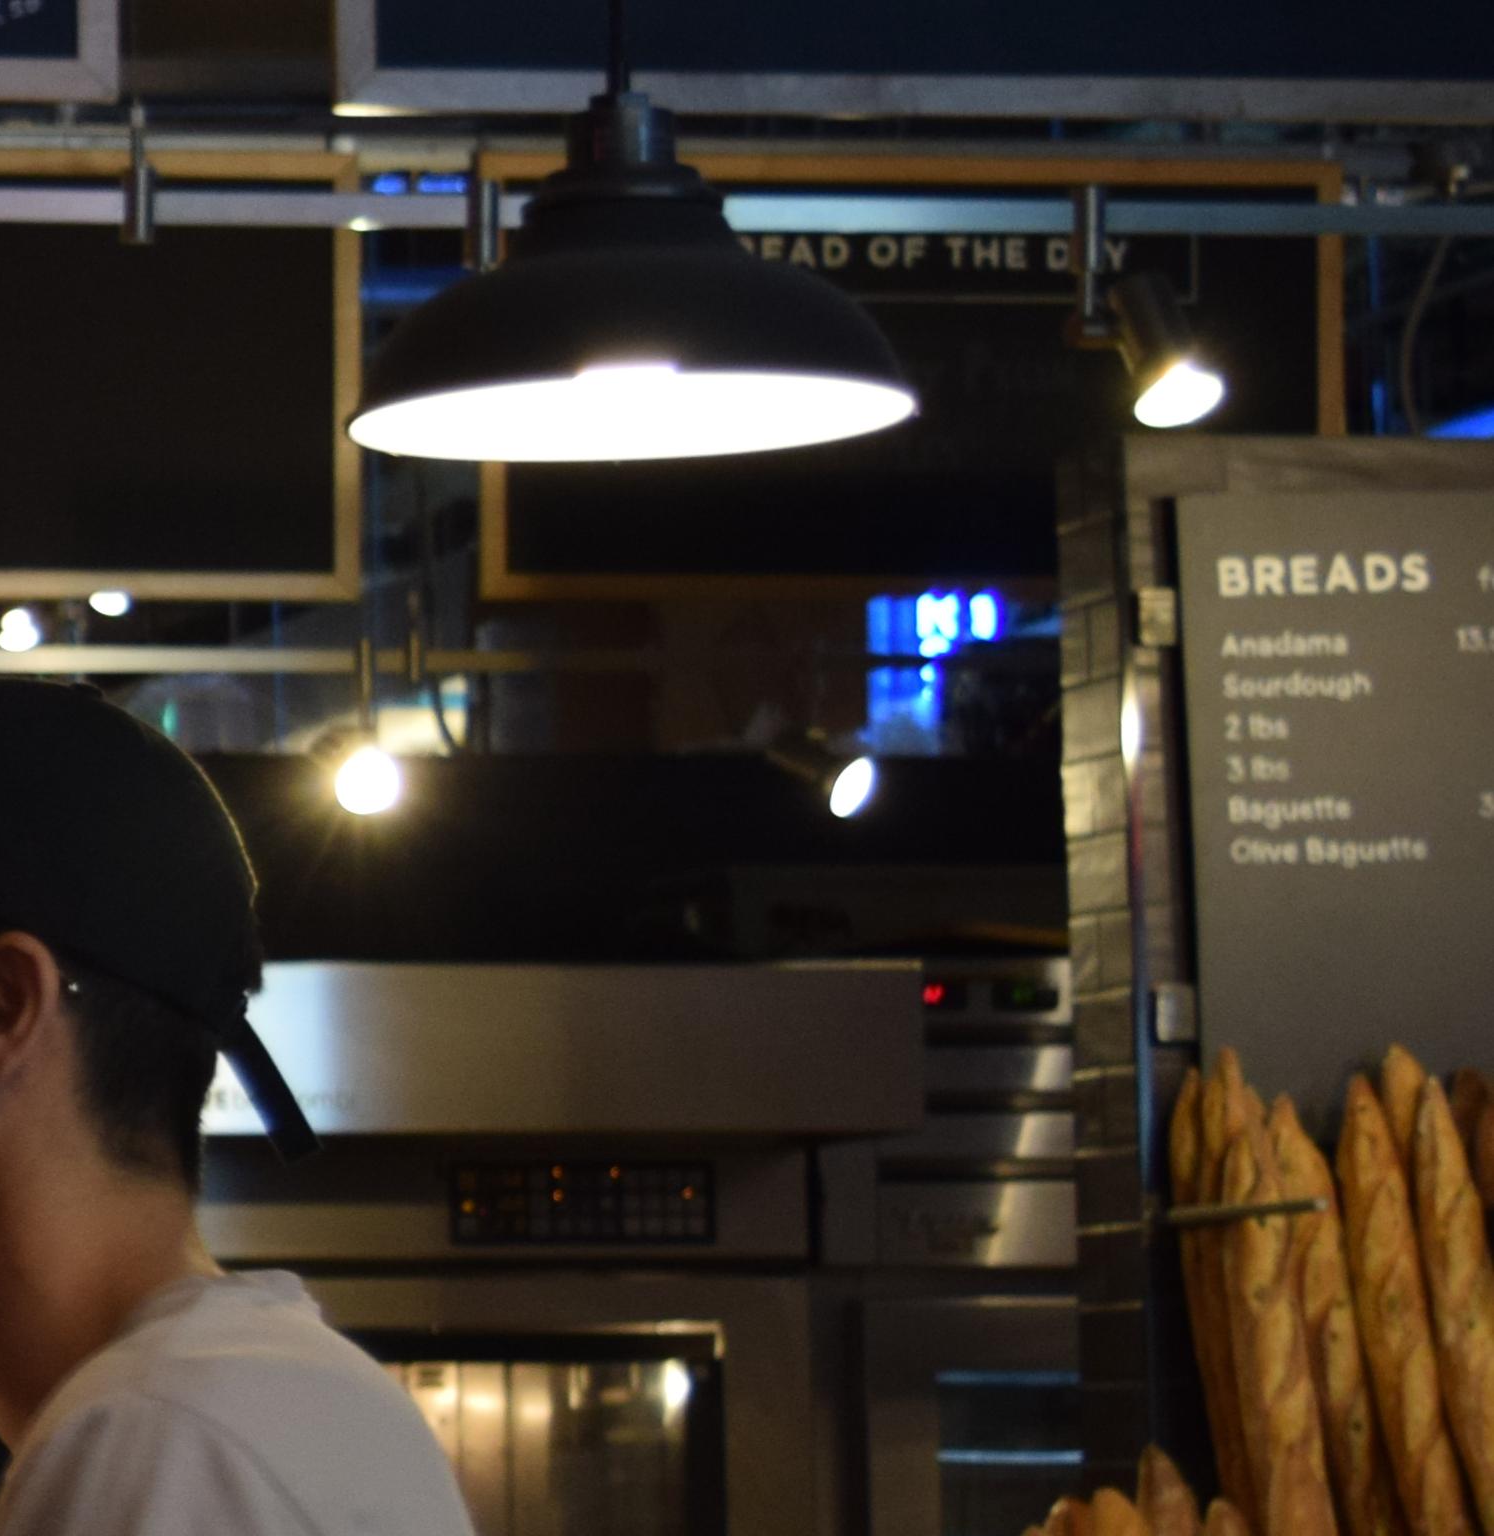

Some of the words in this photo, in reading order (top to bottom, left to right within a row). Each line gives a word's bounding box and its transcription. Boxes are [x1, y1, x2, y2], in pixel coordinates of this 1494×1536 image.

[867, 234, 928, 269] OF
[944, 235, 1030, 269] THE
[1047, 235, 1129, 271] DY
[1217, 552, 1432, 598] BREADS
[1222, 670, 1373, 701] Sourdough
[1227, 795, 1352, 831] Baguette
[1230, 835, 1298, 864] Olive
[1304, 835, 1430, 869] Baguette
